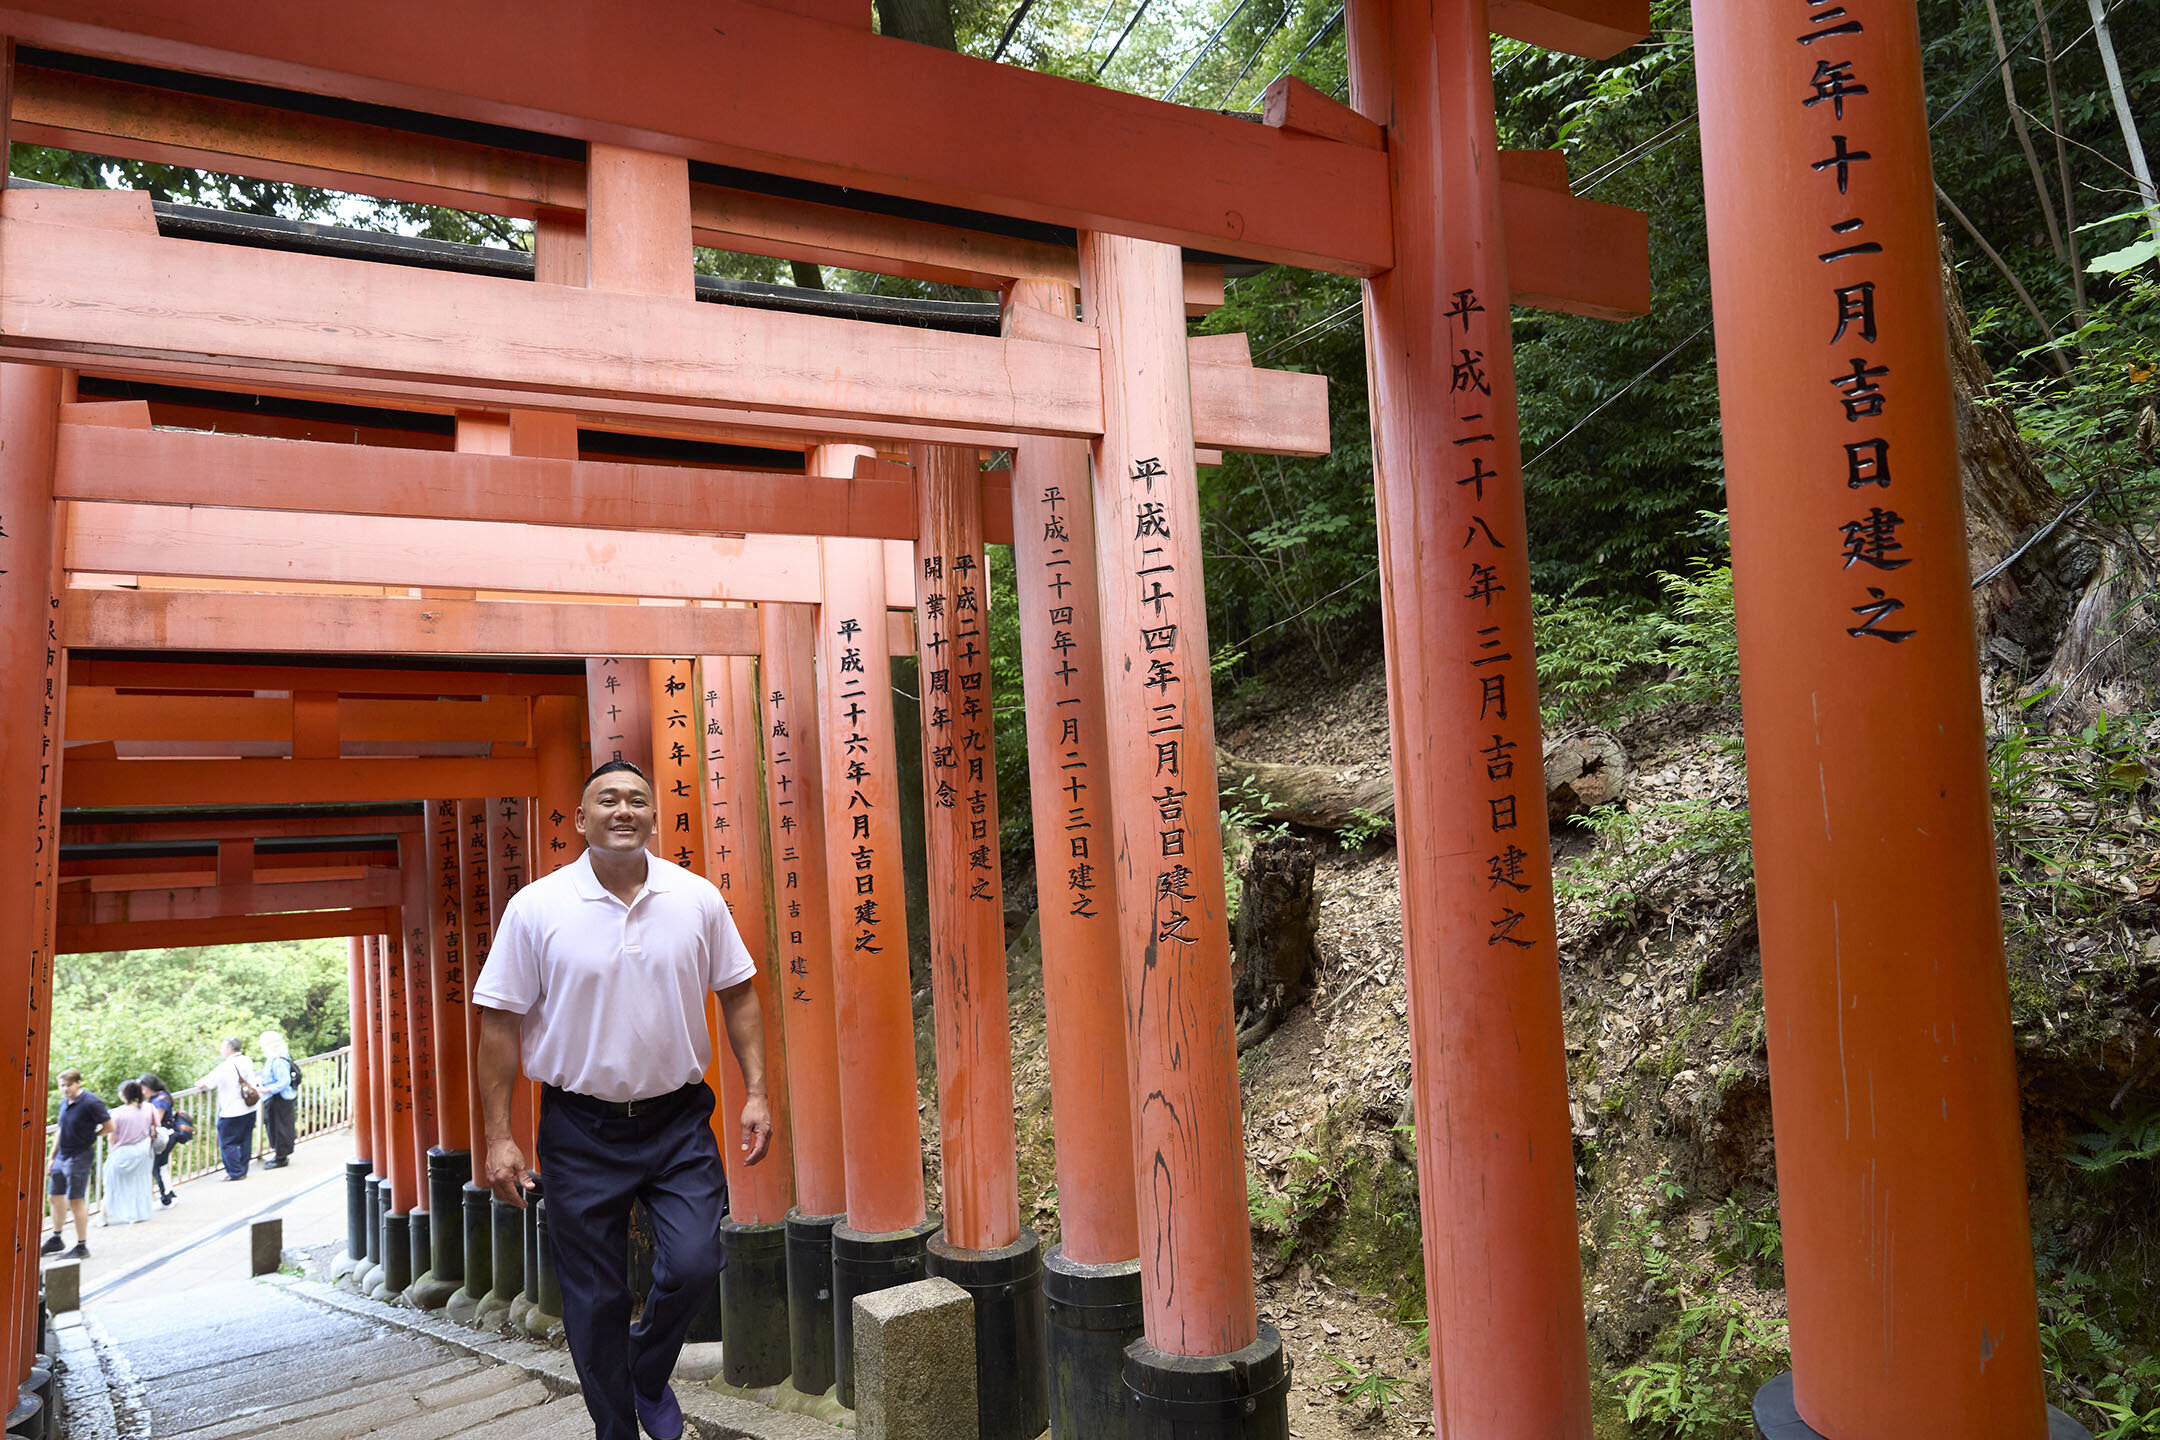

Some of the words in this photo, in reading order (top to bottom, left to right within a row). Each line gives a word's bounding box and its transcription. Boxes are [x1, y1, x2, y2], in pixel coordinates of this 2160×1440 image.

[664, 658, 694, 869] 和六年七月吉
[924, 555, 958, 808] 開業十周年記念
[952, 554, 994, 902] 平成二十四年九月吉日建之
[1041, 487, 1099, 919] 平成二十四年十一月二十三日建之
[1131, 457, 1198, 946] 平成二十四年三月吉日建之
[1444, 288, 1536, 948] 平成二十八年三月吉日建之
[470, 814, 491, 1015] 平成二十五年一月吉
[500, 797, 522, 902] 成十八年一月
[769, 690, 812, 1003] 平成二十一年三月吉日建之
[837, 618, 883, 954] 平成二十六年八月吉日建之
